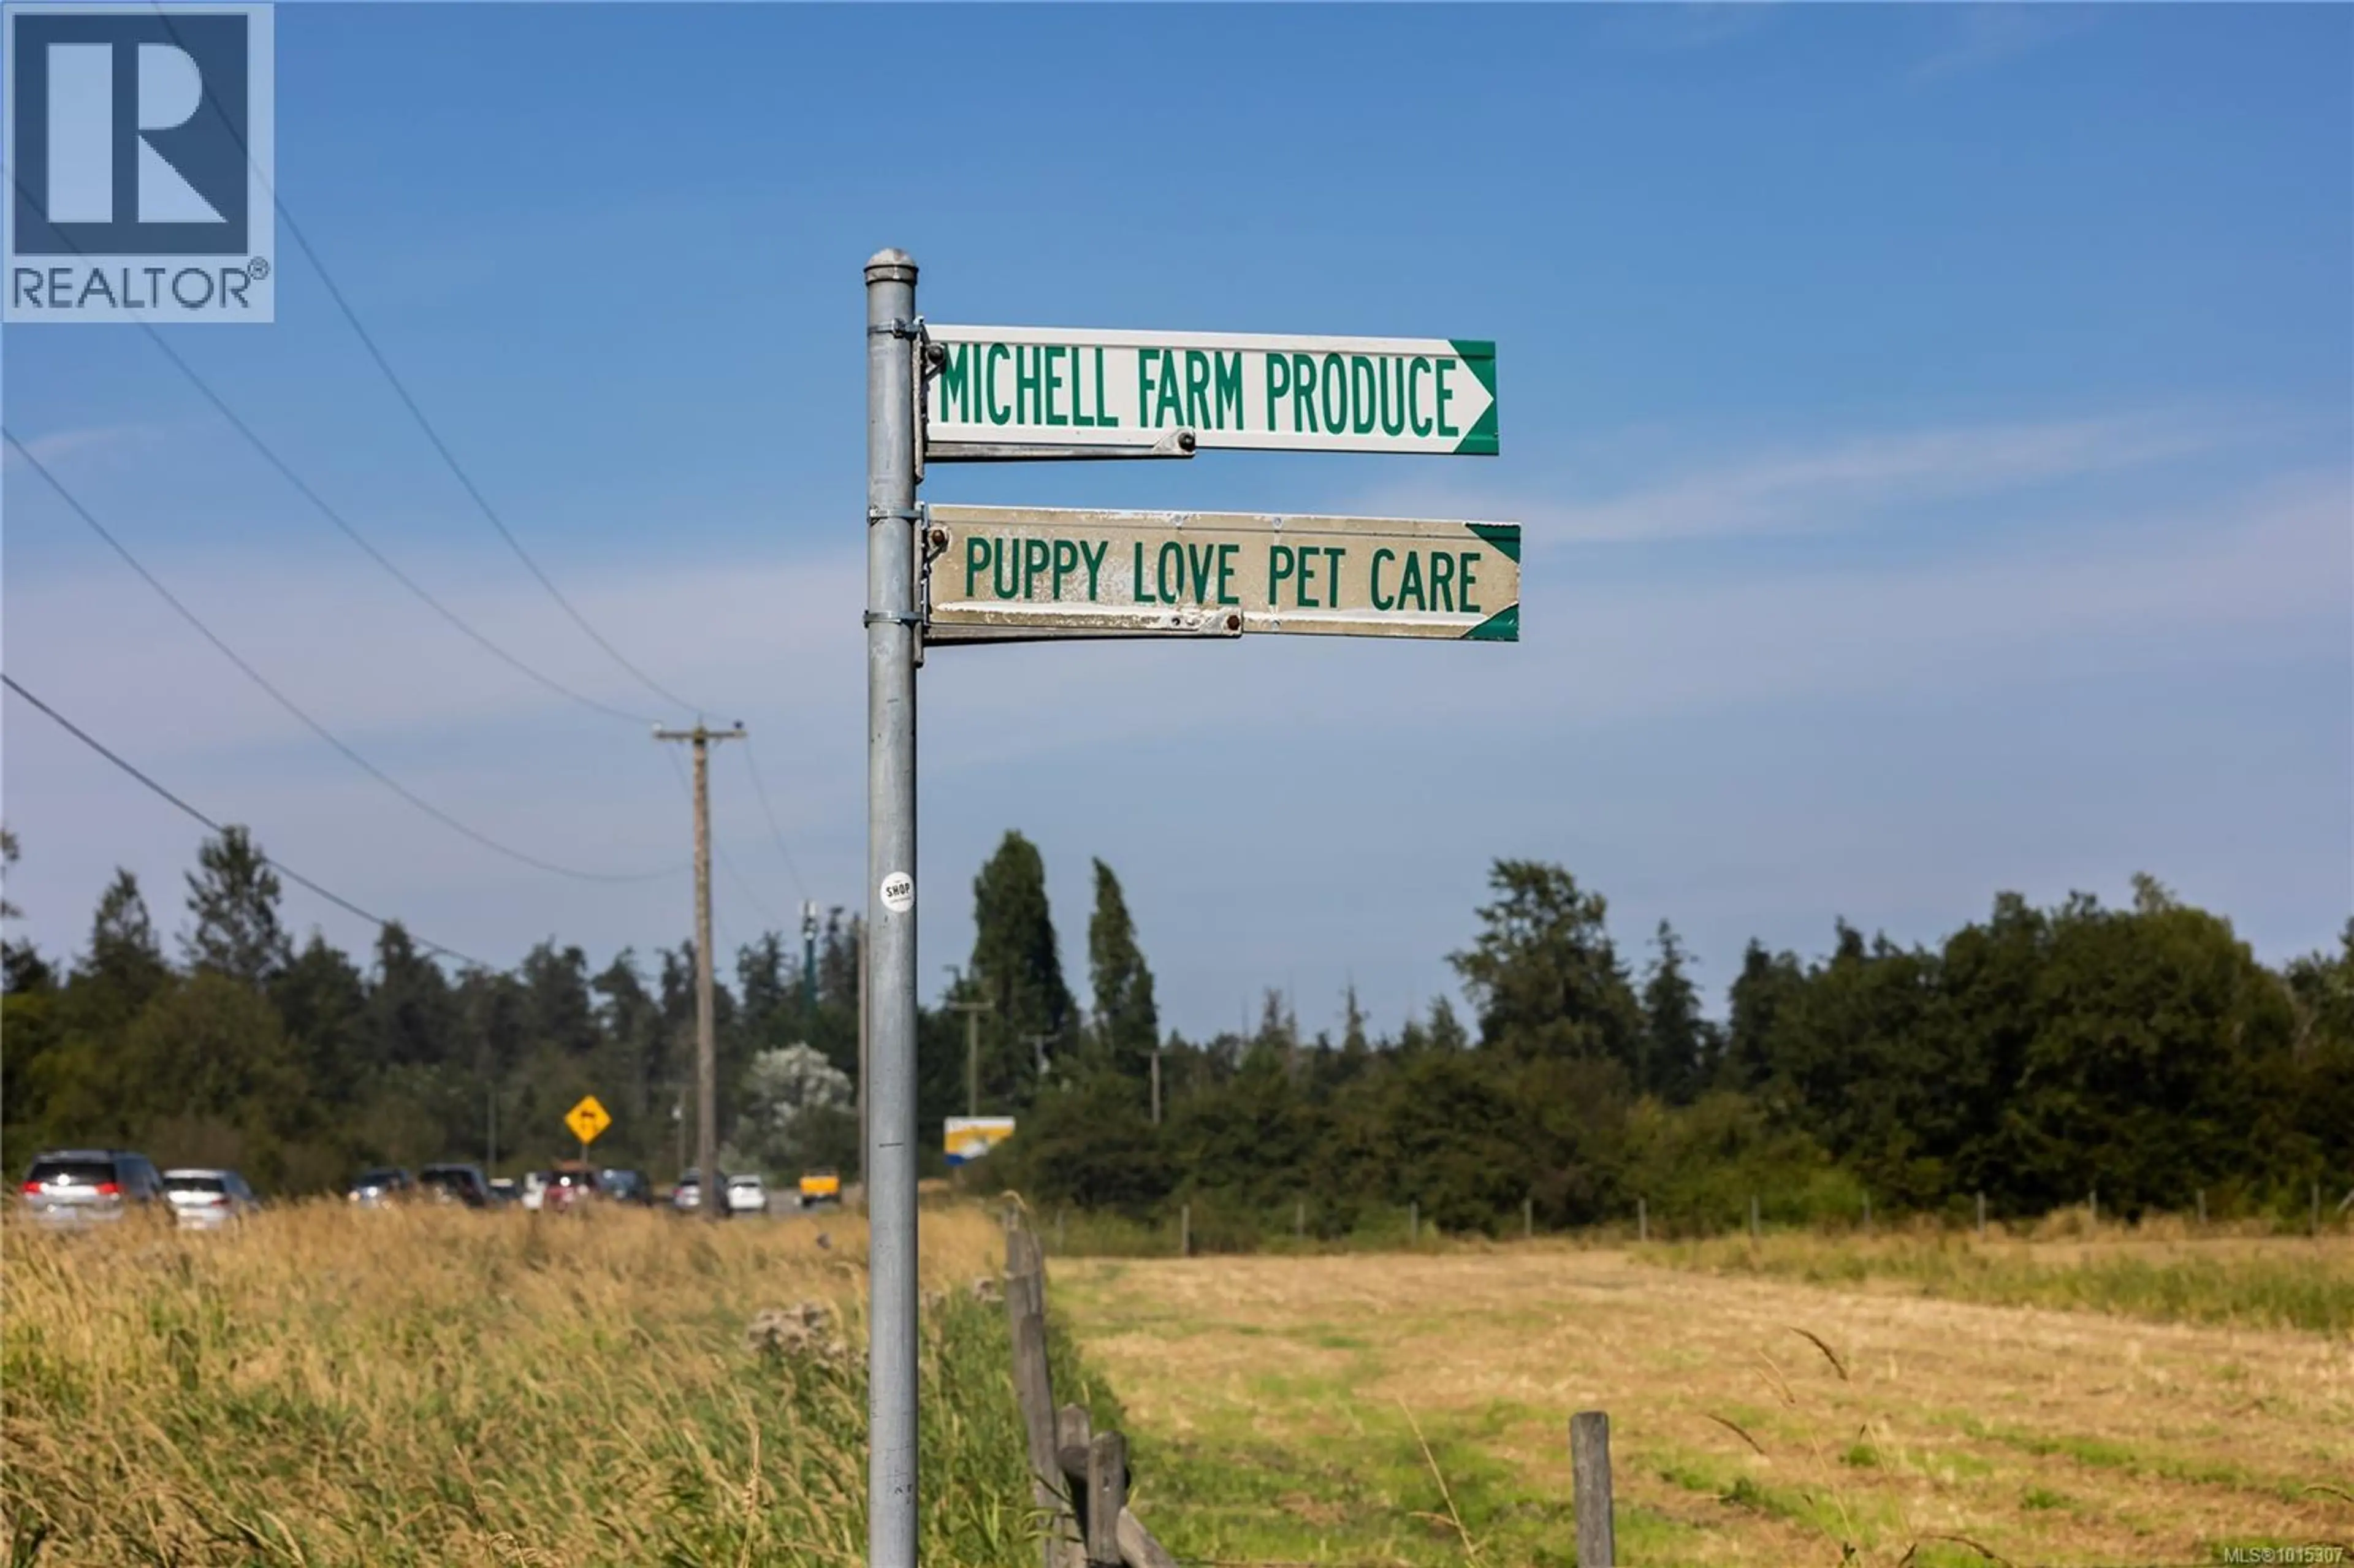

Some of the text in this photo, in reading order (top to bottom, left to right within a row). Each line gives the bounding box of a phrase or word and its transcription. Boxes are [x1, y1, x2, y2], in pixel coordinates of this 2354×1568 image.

[941, 343, 1460, 438] MICHELL FARM PRODUCE
[966, 536, 1482, 614] PUPPY LOVE PET CARE
[886, 883, 910, 897] SHOP
